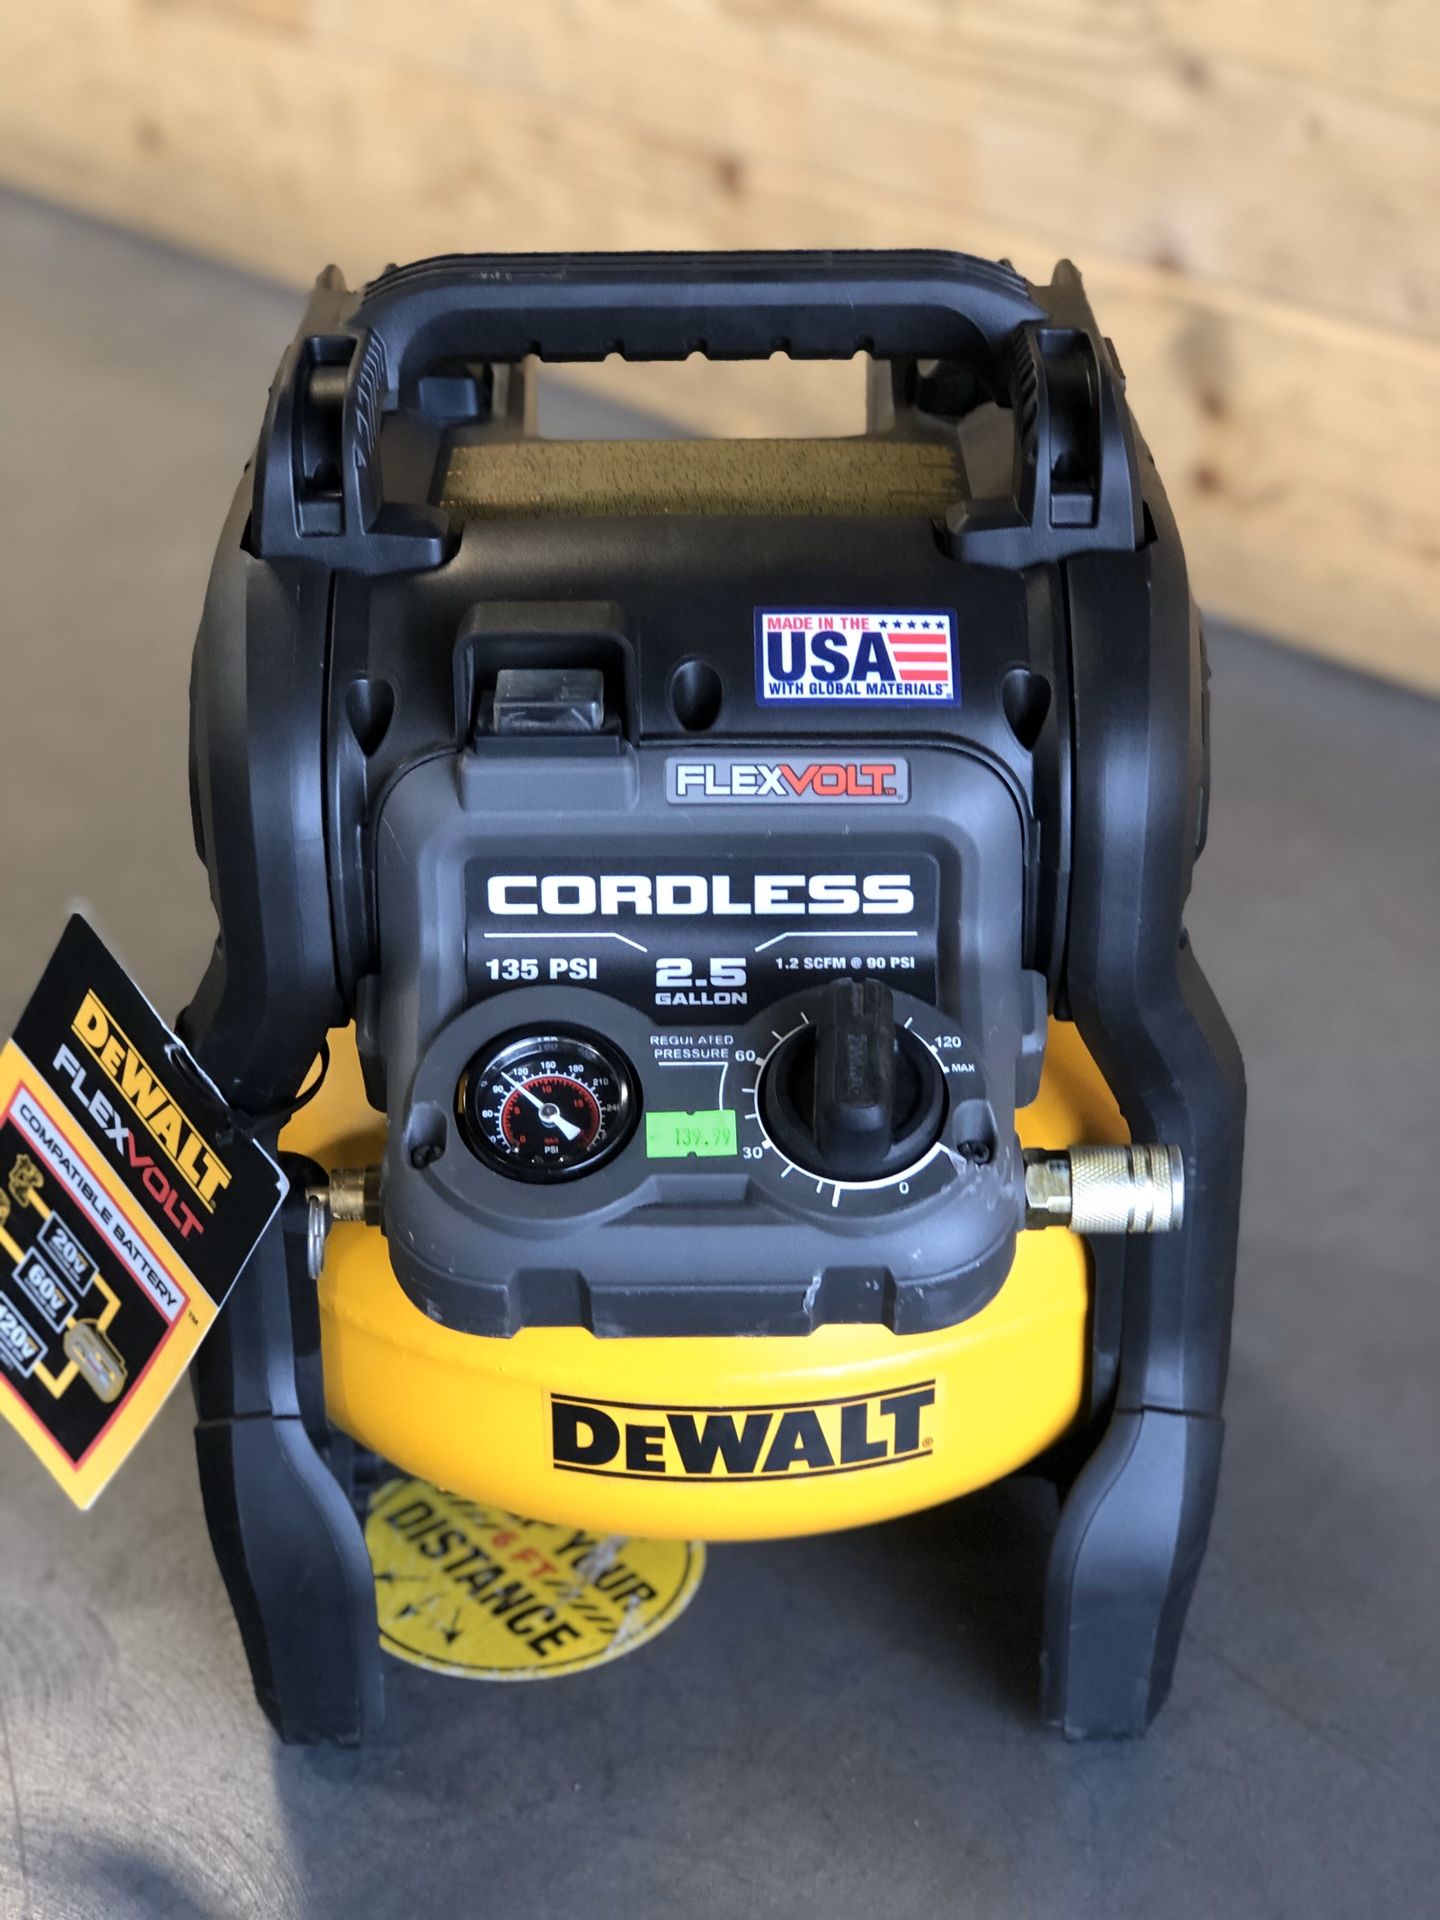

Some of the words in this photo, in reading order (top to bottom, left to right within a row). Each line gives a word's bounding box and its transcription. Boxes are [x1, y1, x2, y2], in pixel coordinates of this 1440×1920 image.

[767, 617, 813, 630] MADE
[818, 617, 833, 630] IN
[841, 617, 870, 630] THE
[767, 631, 896, 682] USA
[769, 682, 804, 695] WITH
[809, 683, 861, 696] GLOBAL
[487, 875, 914, 915] CORDLESS
[486, 958, 539, 981] 135
[549, 957, 598, 980] PSI
[775, 957, 799, 970] 1.2
[804, 957, 847, 969] SCFM
[866, 957, 886, 969] 90
[890, 956, 915, 969] PSI
[655, 957, 747, 987] 2.5
[655, 992, 748, 1006] GALLON
[650, 1035, 734, 1046] REGULATED
[935, 1035, 962, 1048] 120
[654, 1048, 729, 1060] PRESSURE
[735, 1050, 756, 1062] 60
[513, 1067, 529, 1076] 120
[952, 1063, 975, 1073] MAX
[492, 1085, 504, 1094] 90
[73, 992, 230, 1202] DEWALT
[52, 1043, 204, 1238] FLEXVOLT
[544, 1146, 559, 1154] PSI
[742, 1147, 763, 1159] 30
[899, 1181, 909, 1194] 0
[20, 1104, 112, 1225] COMPATIBLE
[113, 1225, 178, 1306] BATTERY
[551, 1388, 935, 1475] DEWALT
[386, 1500, 581, 1657] DISTANCE
